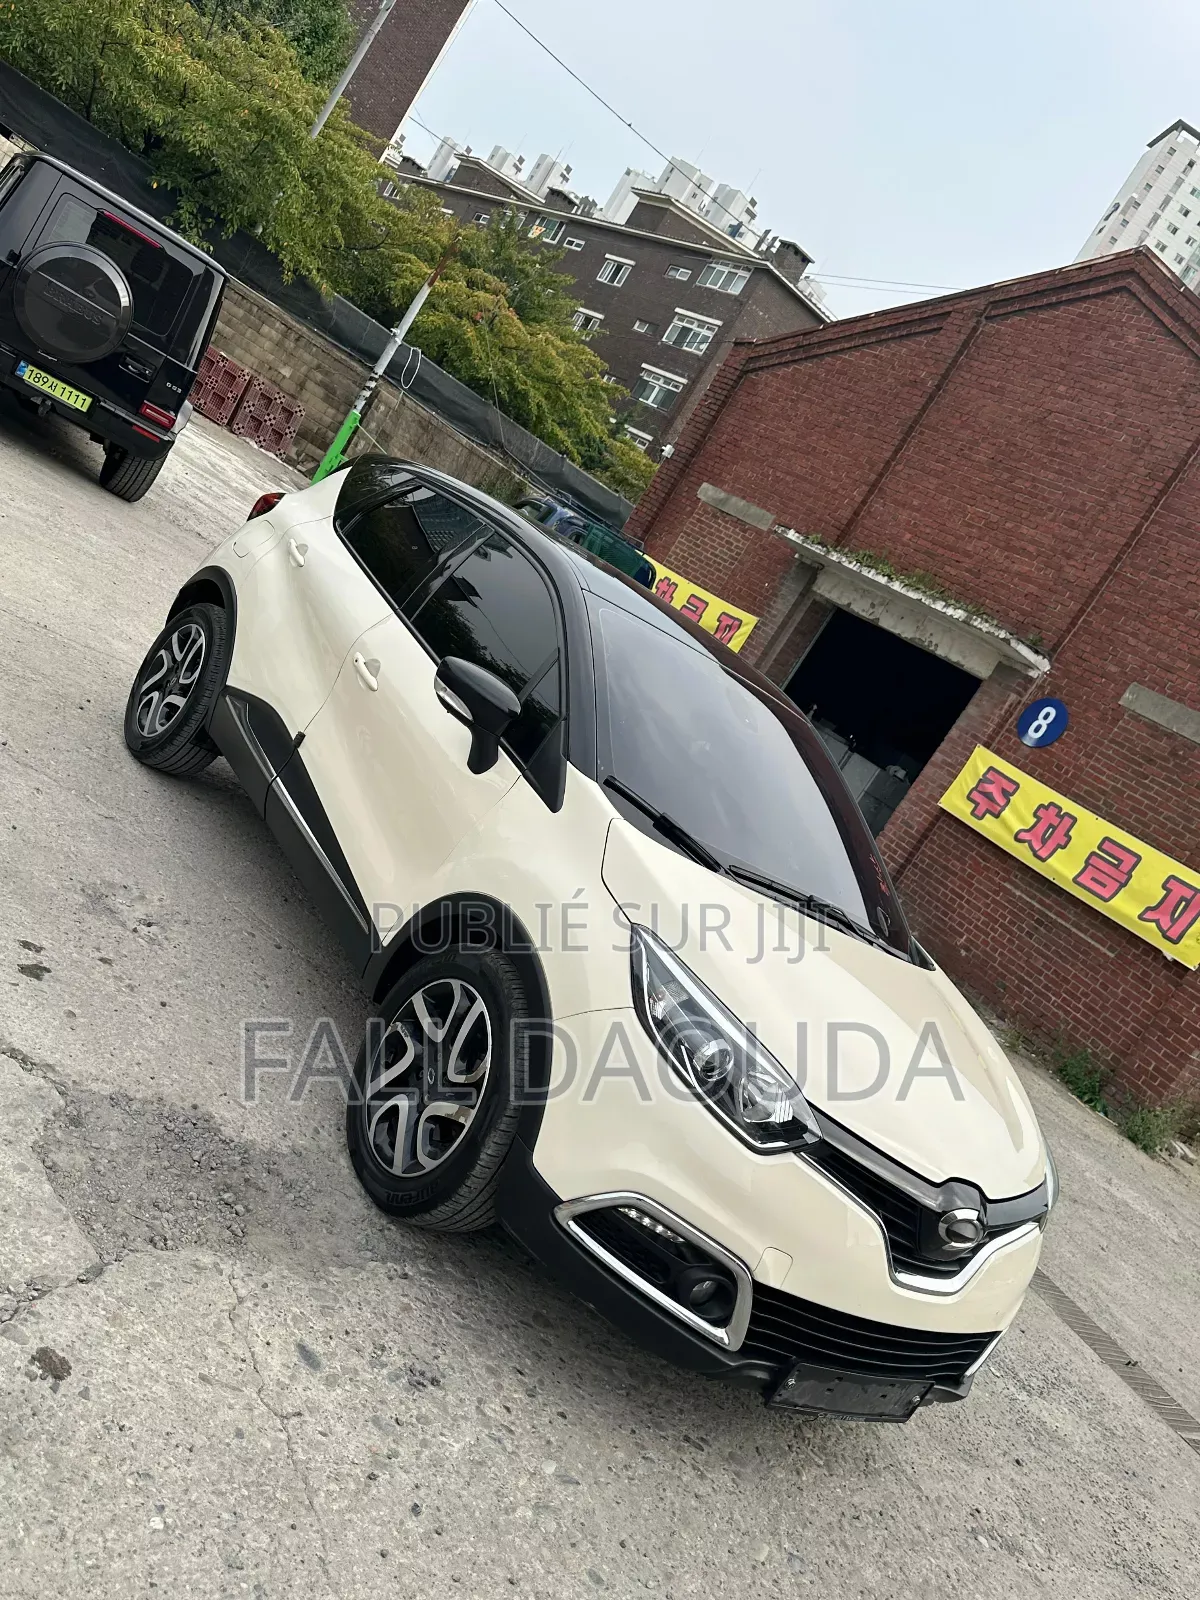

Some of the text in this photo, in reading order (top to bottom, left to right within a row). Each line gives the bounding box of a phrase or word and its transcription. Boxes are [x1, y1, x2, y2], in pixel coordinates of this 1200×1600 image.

[60, 386, 88, 409] 1111
[1027, 705, 1057, 740] 8
[966, 765, 1200, 945] 주차금지
